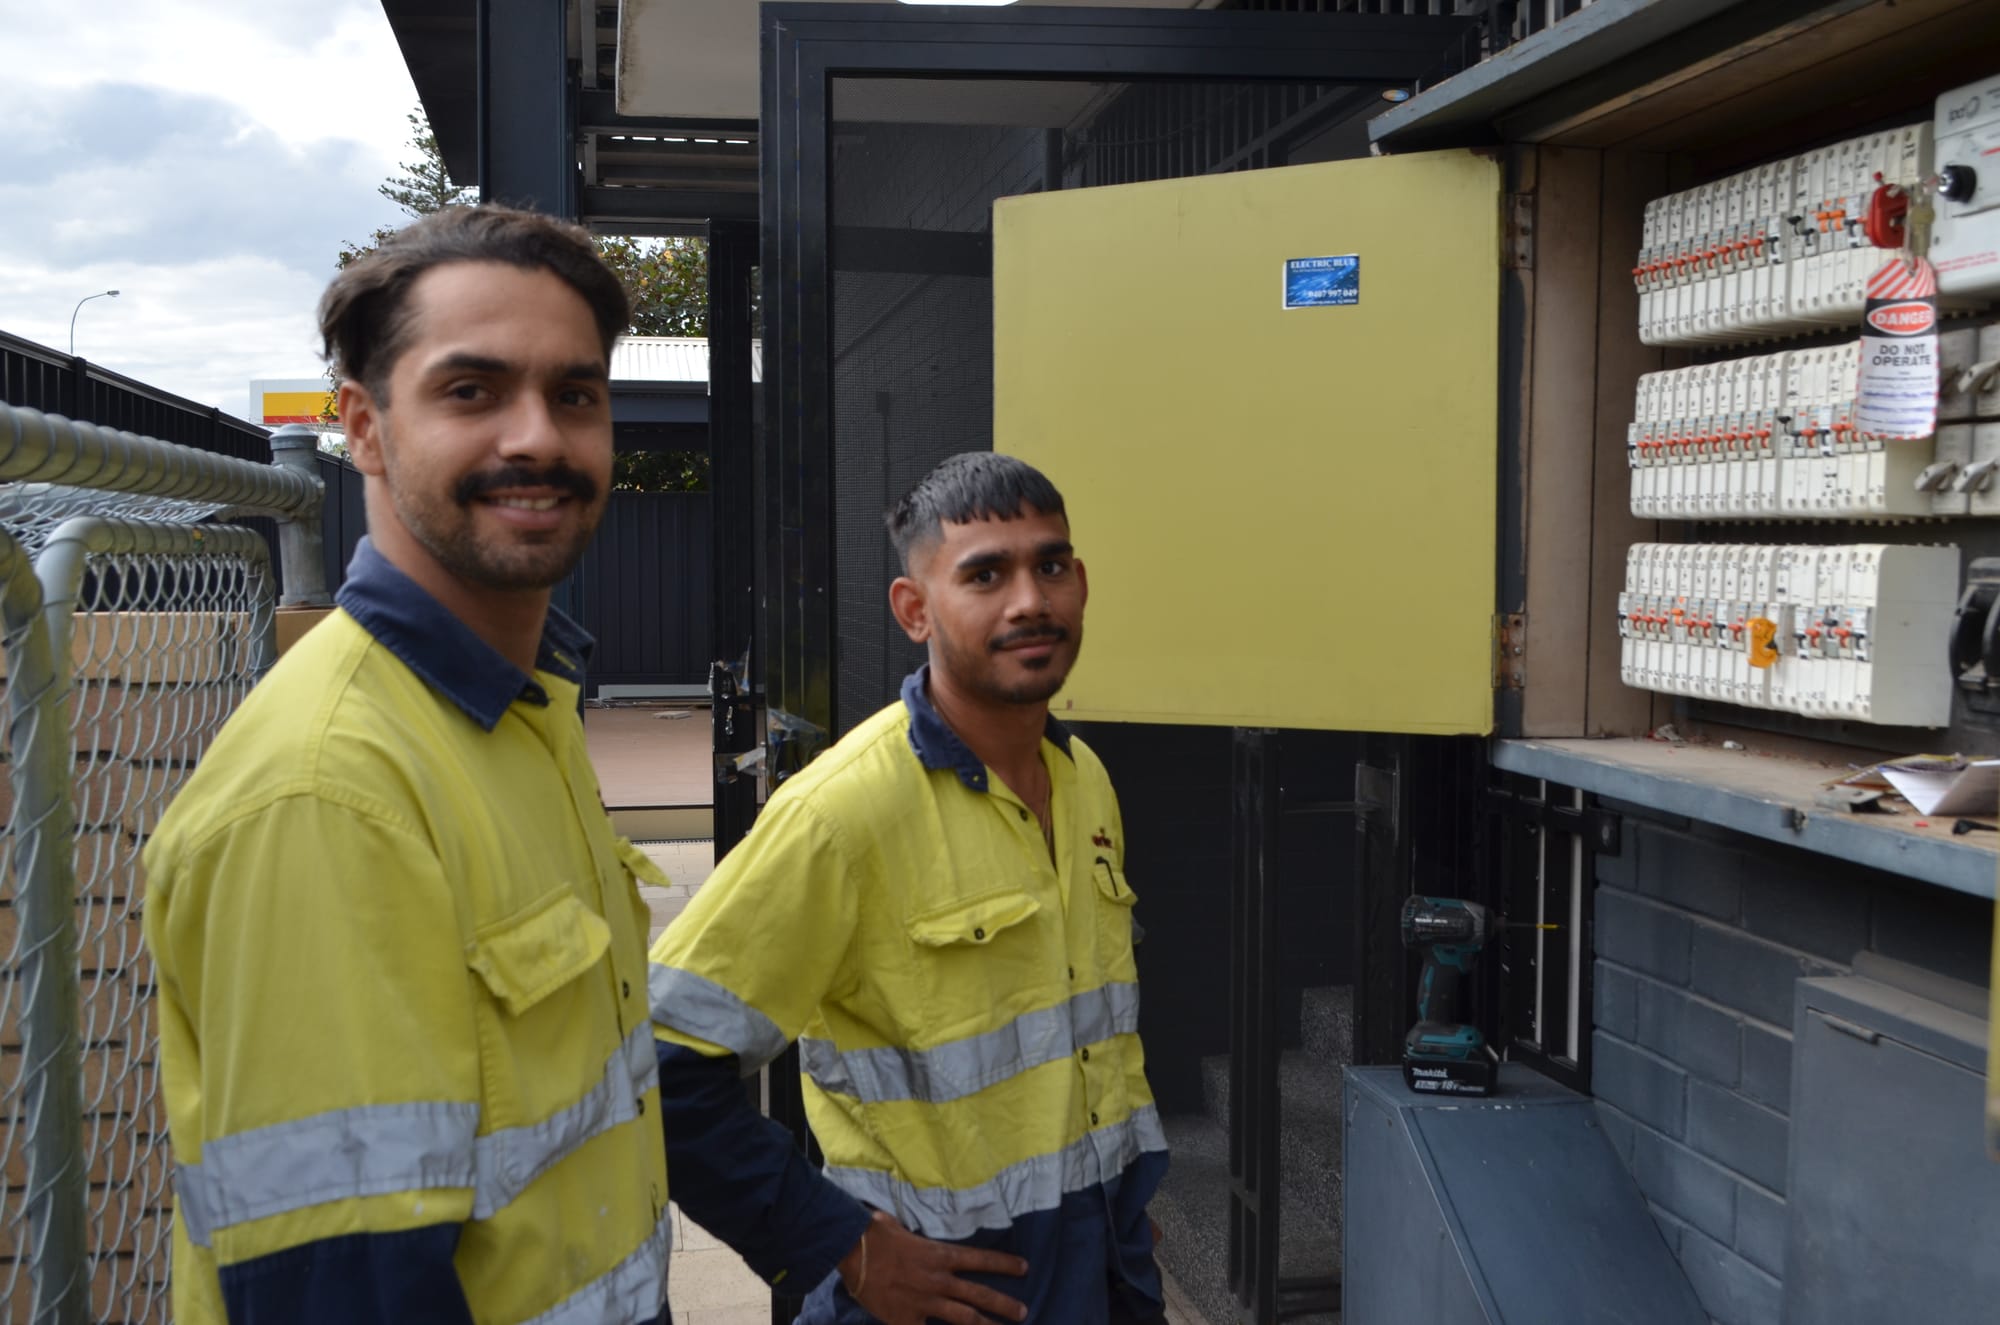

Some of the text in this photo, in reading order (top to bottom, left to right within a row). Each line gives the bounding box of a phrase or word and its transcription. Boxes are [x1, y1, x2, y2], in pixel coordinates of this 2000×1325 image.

[1290, 258, 1356, 269] ELECTRIC BLUE
[1875, 311, 1935, 326] DANGER
[1880, 343, 1926, 356] DO NOT
[1872, 355, 1932, 367] OPERATE
